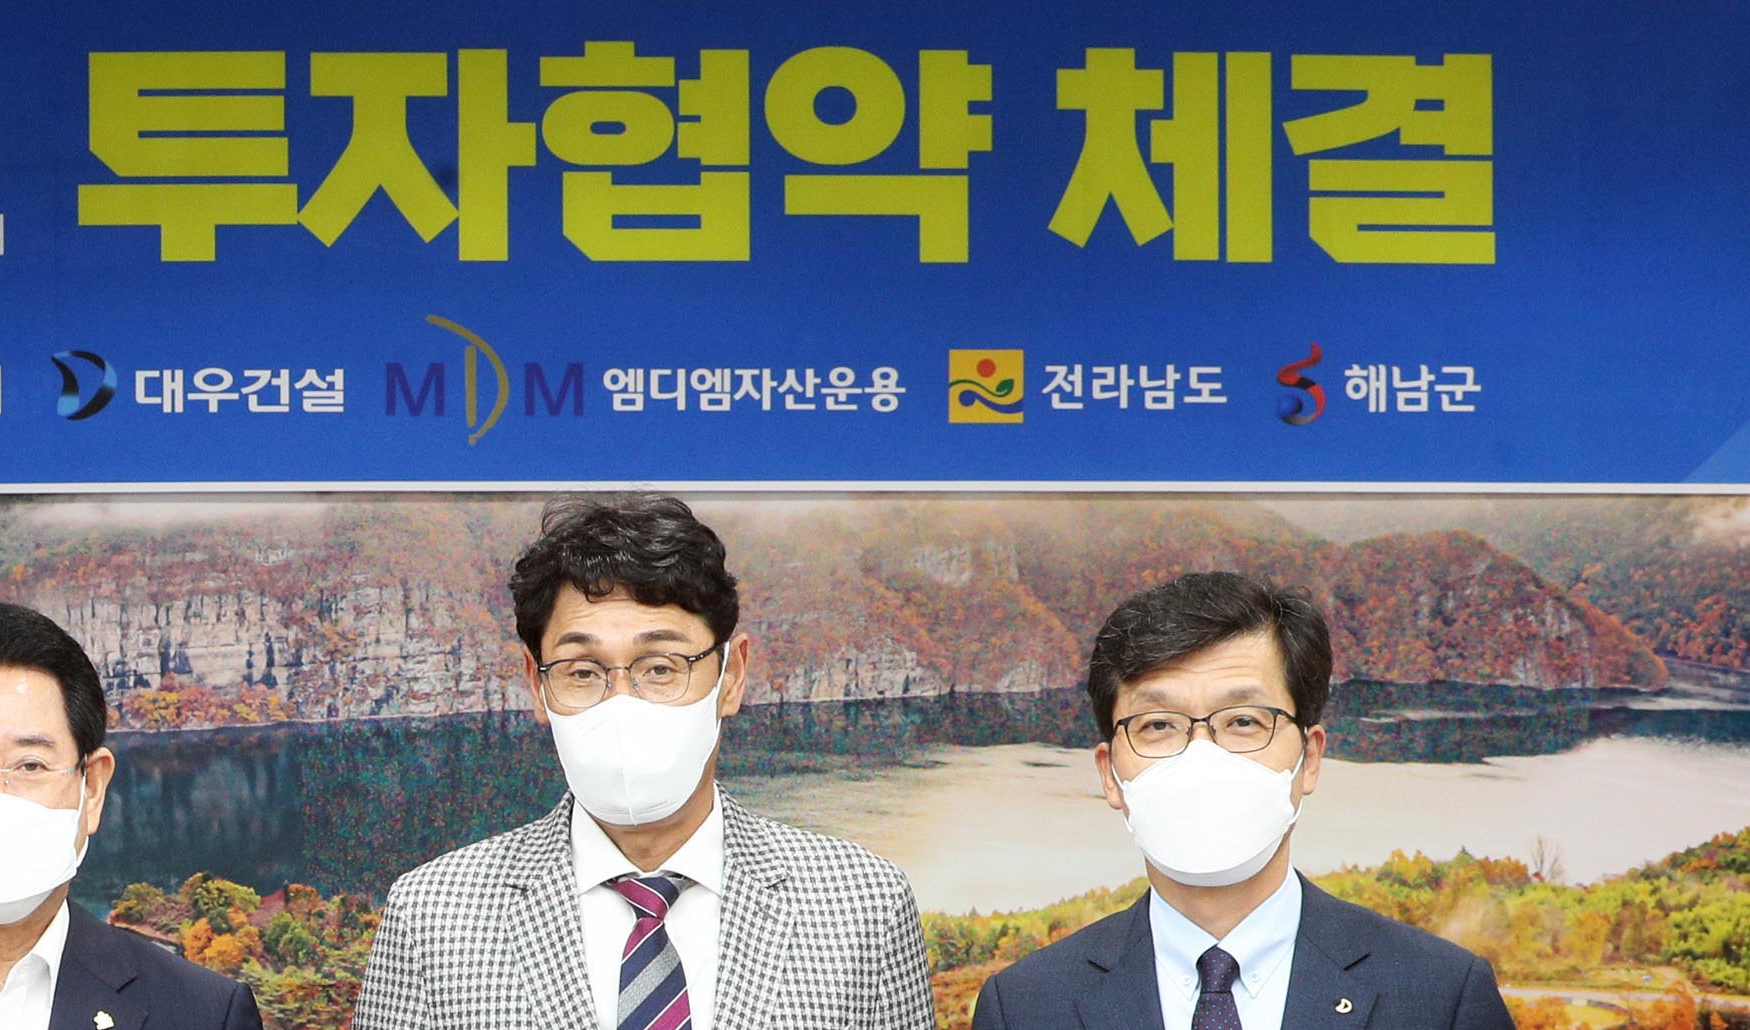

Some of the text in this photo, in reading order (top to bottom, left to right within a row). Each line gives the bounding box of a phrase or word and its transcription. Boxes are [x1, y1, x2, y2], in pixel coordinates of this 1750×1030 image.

[78, 41, 992, 263] 투자협약
[1048, 48, 1496, 265] 체결
[135, 367, 345, 414] 대우건설
[602, 366, 907, 413] 엠디엠자산운용
[1041, 363, 1228, 410] 전라남도
[1344, 363, 1482, 413] 해남군
